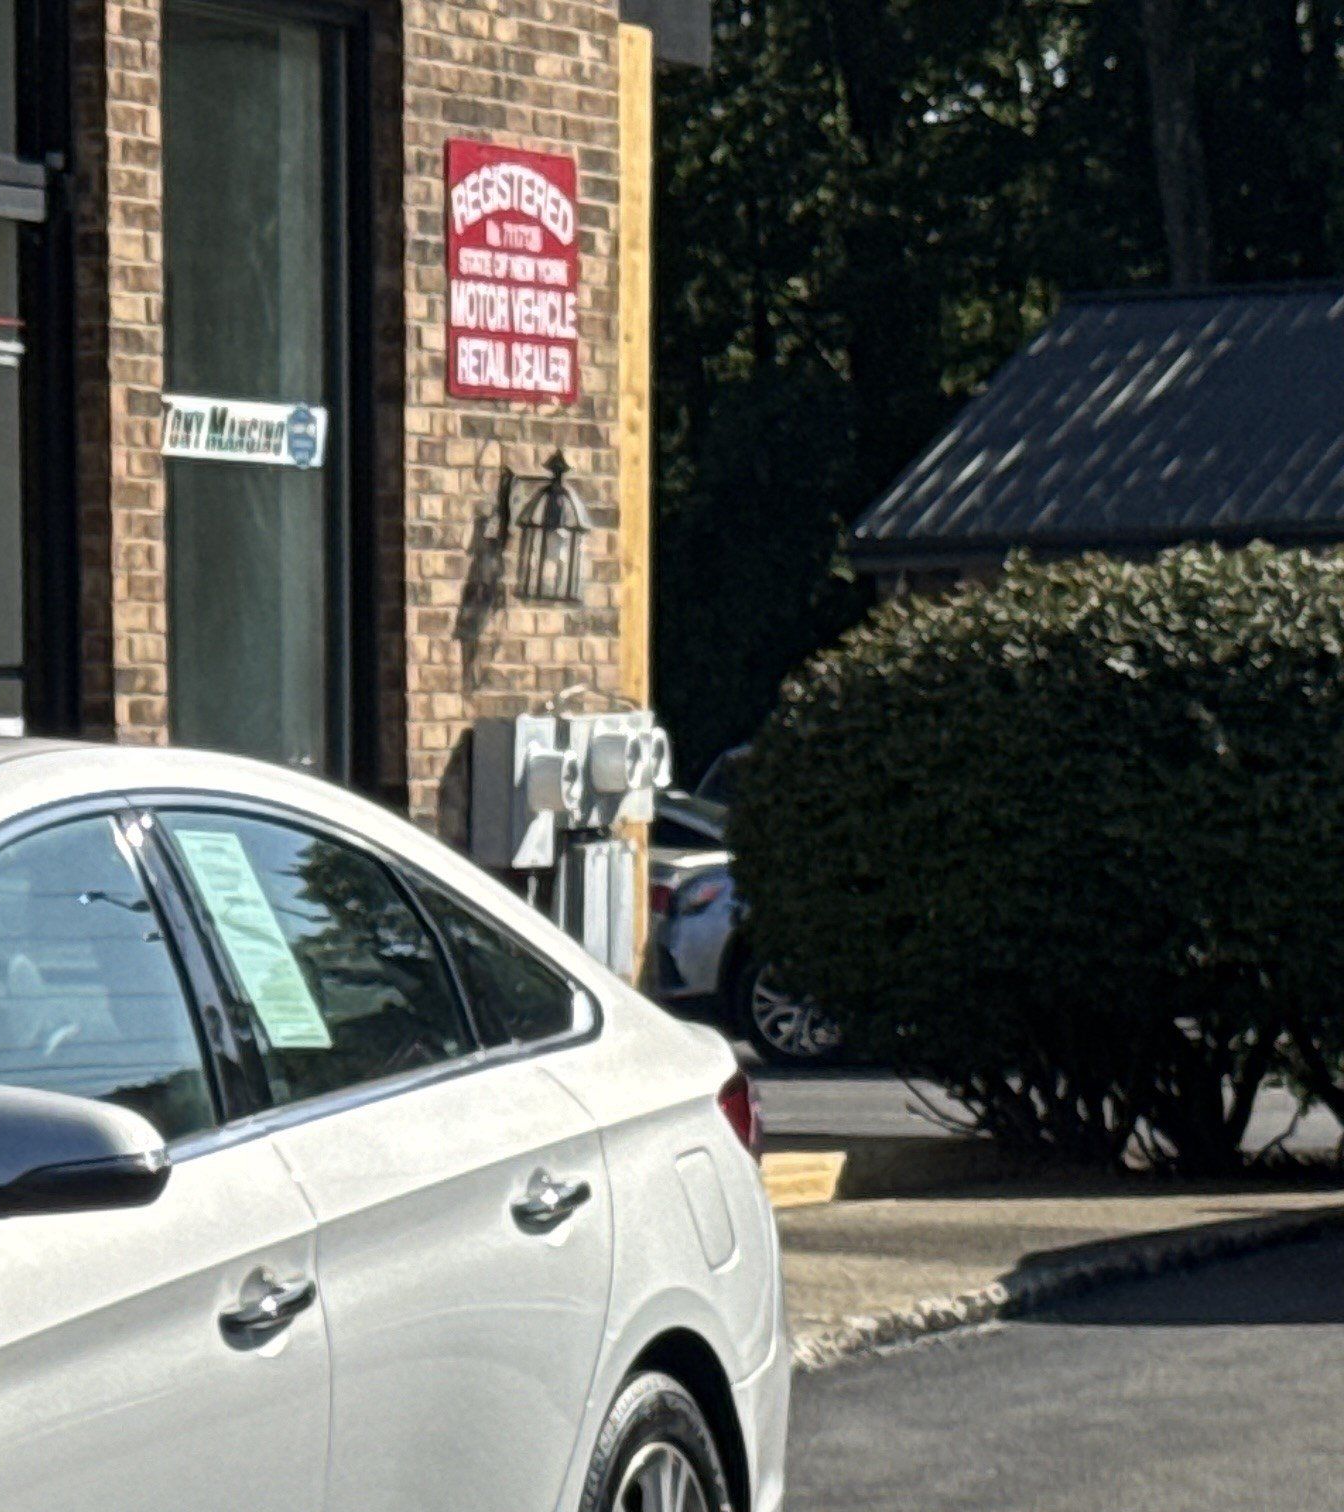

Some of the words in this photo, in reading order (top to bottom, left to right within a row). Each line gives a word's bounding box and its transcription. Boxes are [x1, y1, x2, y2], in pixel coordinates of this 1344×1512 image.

[451, 161, 574, 246] REGISTERED
[450, 278, 510, 333] MOTOR
[511, 285, 578, 339] VEHICLE
[457, 336, 511, 389] RETAIL
[511, 341, 573, 394] DEALER
